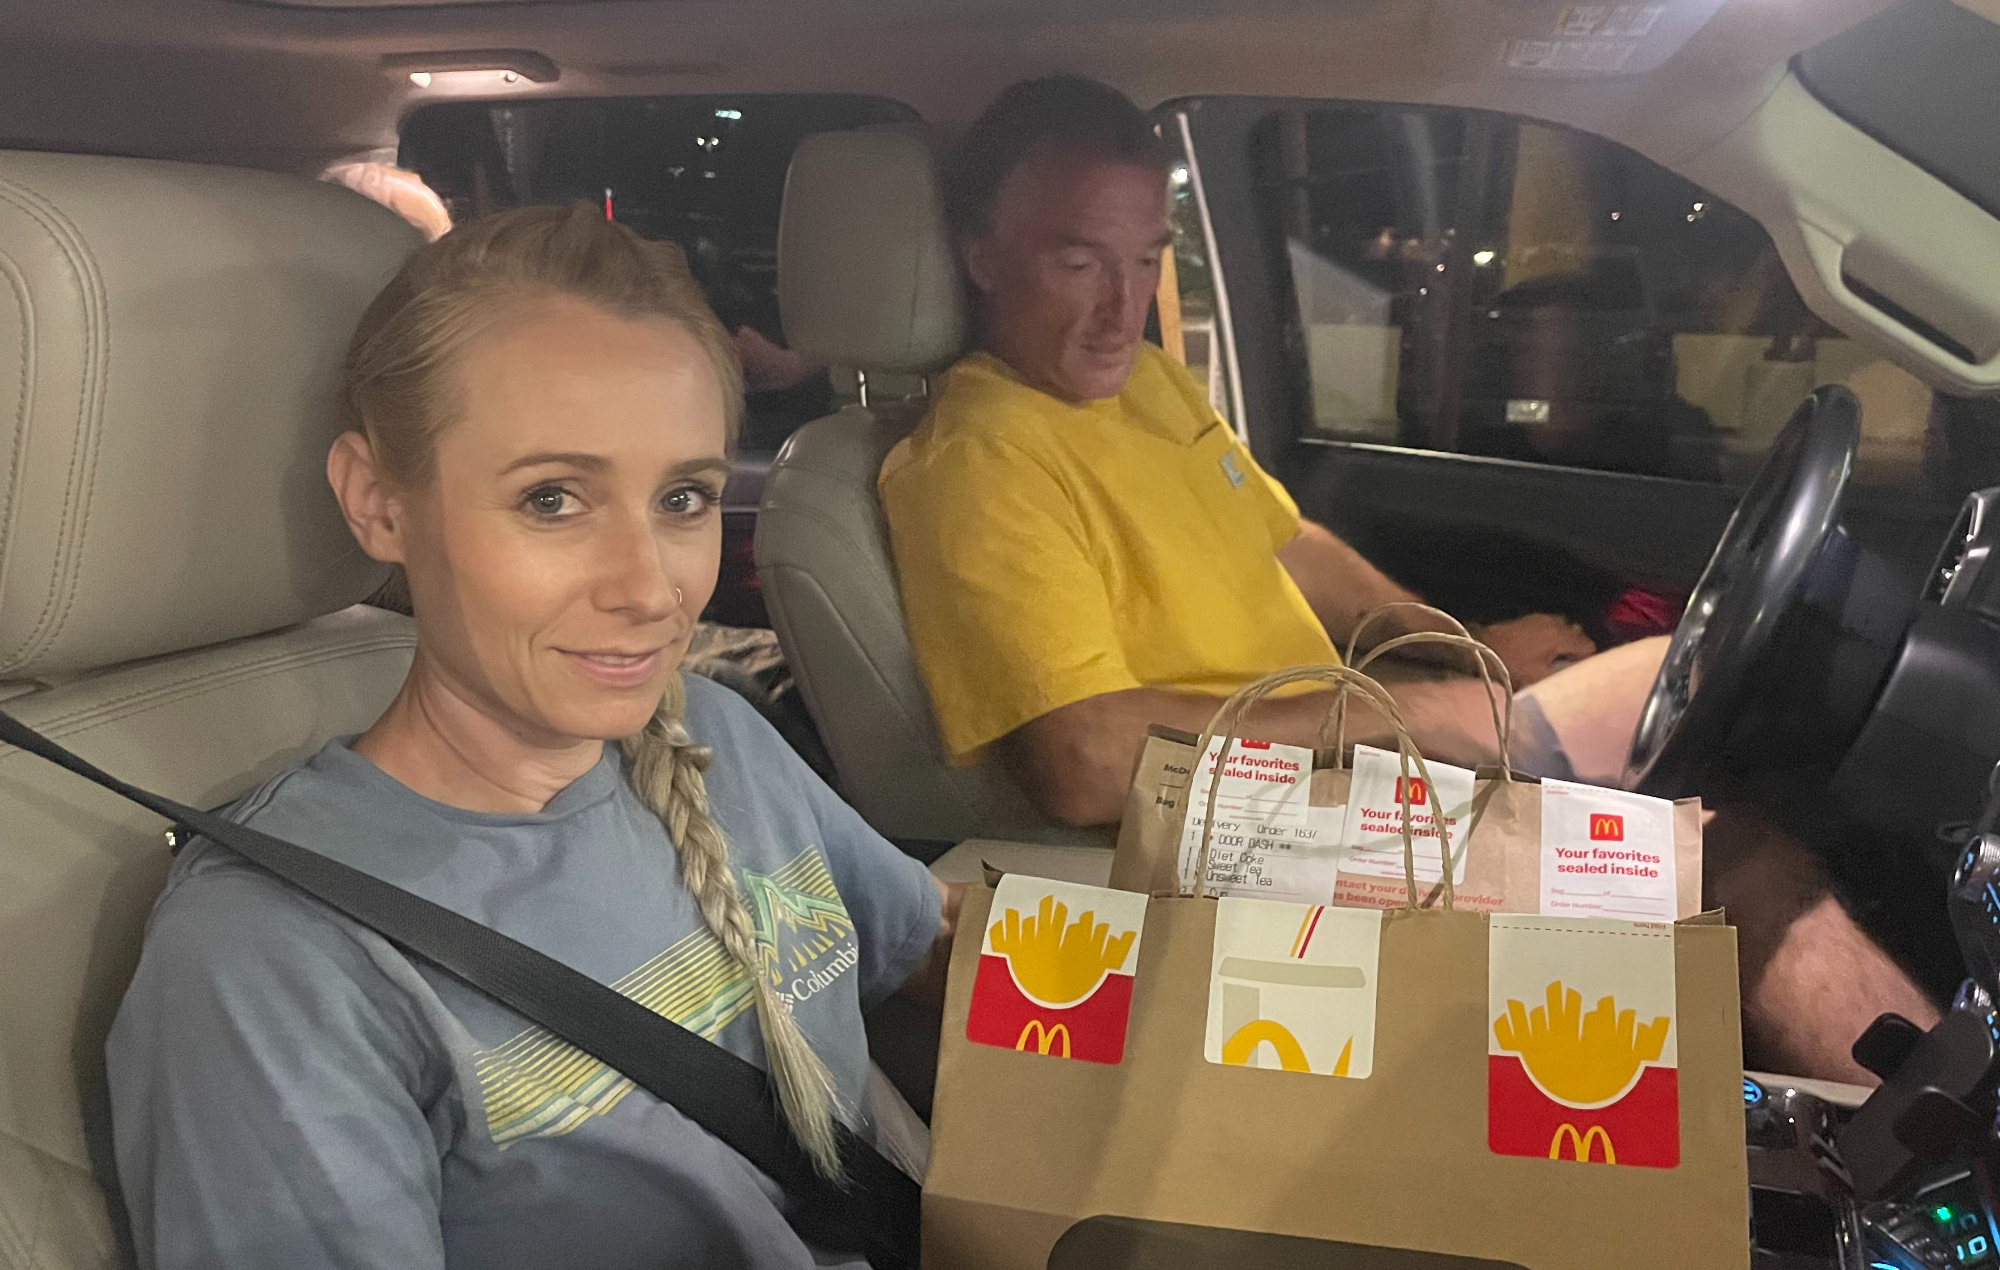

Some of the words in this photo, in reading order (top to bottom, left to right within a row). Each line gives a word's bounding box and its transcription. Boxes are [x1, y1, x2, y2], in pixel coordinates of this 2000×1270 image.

[1209, 751, 1239, 764] Yur
[1241, 755, 1300, 771] favorites
[1209, 767, 1253, 780] saled
[1255, 770, 1296, 784] inside
[1361, 808, 1392, 820] Your
[1218, 834, 1244, 847] DOOR
[1248, 838, 1273, 850] DASH
[1240, 851, 1264, 865] Coke
[1555, 848, 1590, 859] Your
[1592, 848, 1661, 864] favorites
[1557, 863, 1608, 874] sealed
[1611, 863, 1659, 878] inside
[1256, 875, 1273, 887] Tea
[1336, 879, 1366, 890] ntact
[1370, 883, 1397, 895] your
[1346, 892, 1376, 905] been
